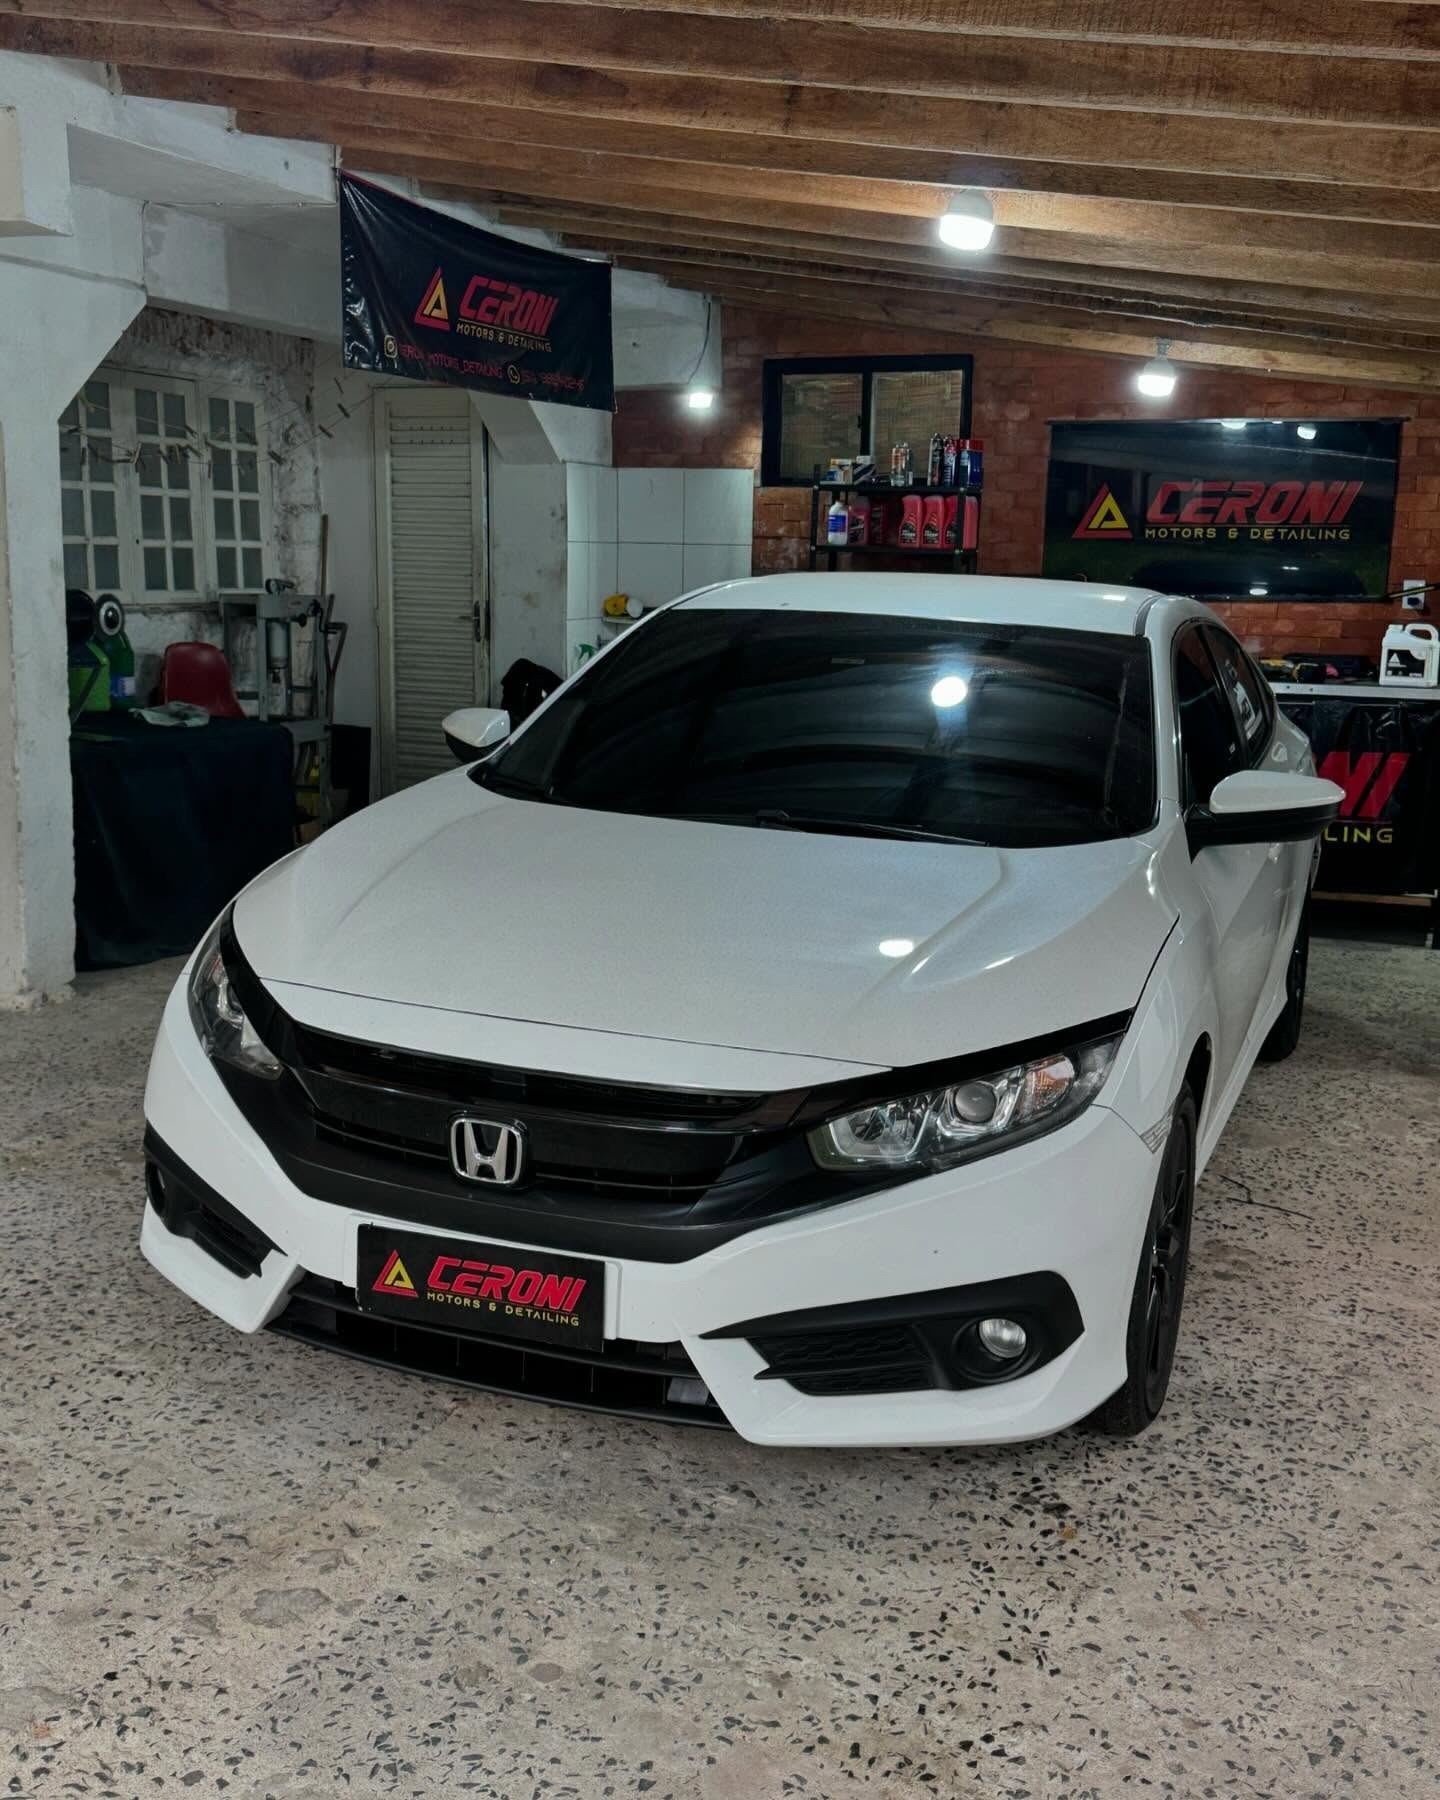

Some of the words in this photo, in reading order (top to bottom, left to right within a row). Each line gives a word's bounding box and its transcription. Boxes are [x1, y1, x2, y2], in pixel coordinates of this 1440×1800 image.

[459, 275, 558, 336] CERONI
[456, 323, 495, 341] MOTORS
[1146, 480, 1363, 524] CERONI
[1144, 527, 1217, 539] MOTORS
[1228, 528, 1239, 539] &
[1250, 528, 1351, 540] DETAILING
[427, 1255, 587, 1312] CERONI
[427, 1291, 481, 1309] MOTORS
[488, 1301, 497, 1312] &
[505, 1304, 580, 1327] DETAILING
